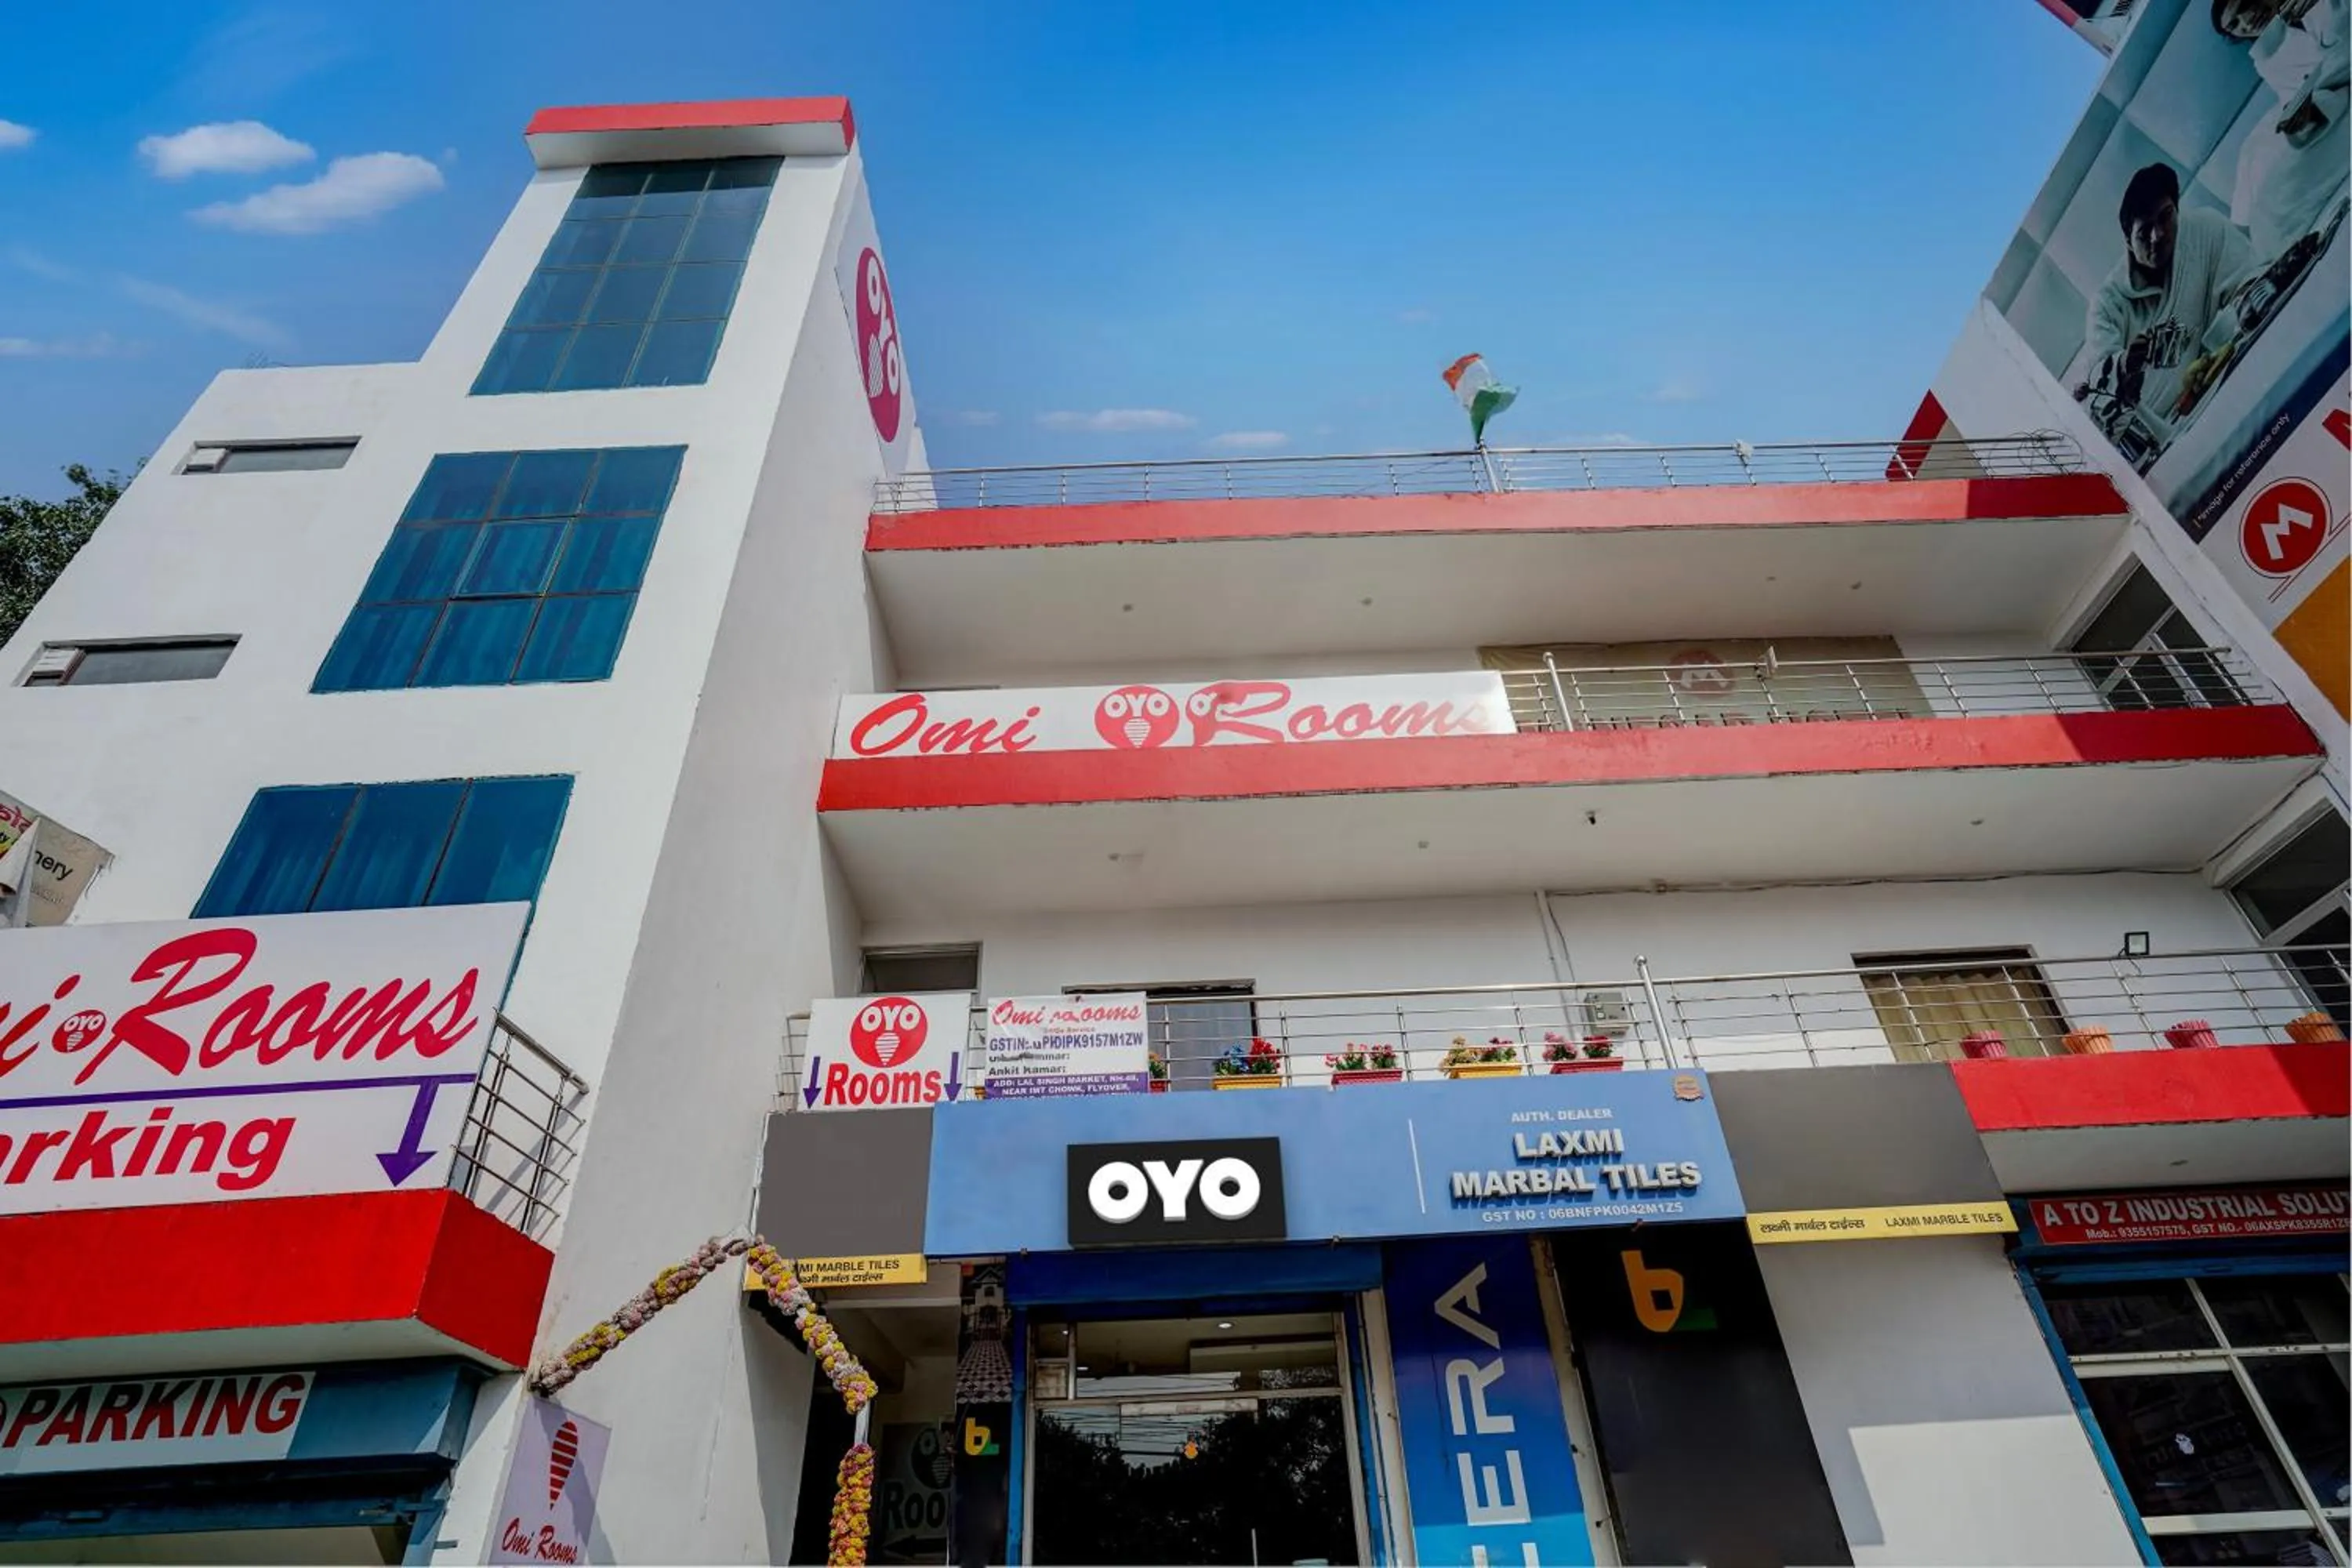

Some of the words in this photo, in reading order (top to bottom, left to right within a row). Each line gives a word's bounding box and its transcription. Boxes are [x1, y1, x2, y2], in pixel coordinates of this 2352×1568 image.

[866, 256, 899, 396] OYO
[2223, 477, 2236, 493] for
[2270, 413, 2290, 434] only
[850, 692, 1041, 756] Omi
[1104, 692, 1170, 718] OYO
[64, 1014, 103, 1034] OYO
[74, 928, 479, 1085] Rooms
[861, 1004, 921, 1032] OYO
[992, 1000, 1045, 1025] Omi
[824, 1062, 941, 1105] Rooms
[1511, 1110, 1554, 1123] AUTH.
[1557, 1108, 1613, 1121] DEALER
[0, 1106, 296, 1190] rking
[1513, 1128, 1625, 1159] LAXMI
[1088, 1157, 1261, 1223] OYO
[1452, 1167, 1597, 1199] MARBAL
[1602, 1161, 1703, 1190] TILES
[1482, 1210, 1512, 1223] GST
[1515, 1209, 1537, 1221] NO
[1885, 1216, 1920, 1228] LAXMI
[1922, 1214, 1969, 1225] MARBLE
[1972, 1212, 2004, 1223] TILES
[2043, 1203, 2063, 1226] A
[2063, 1201, 2100, 1225] TO
[2103, 1200, 2124, 1223] Z
[2127, 1193, 2277, 1223] INDUSTRIAL
[2192, 1223, 2215, 1235] GST
[817, 1261, 864, 1272] MARBLE
[869, 1259, 899, 1270] TILES
[2, 1374, 306, 1448] PARKING
[502, 1517, 535, 1555] Omi
[535, 1525, 578, 1565] Rooms
